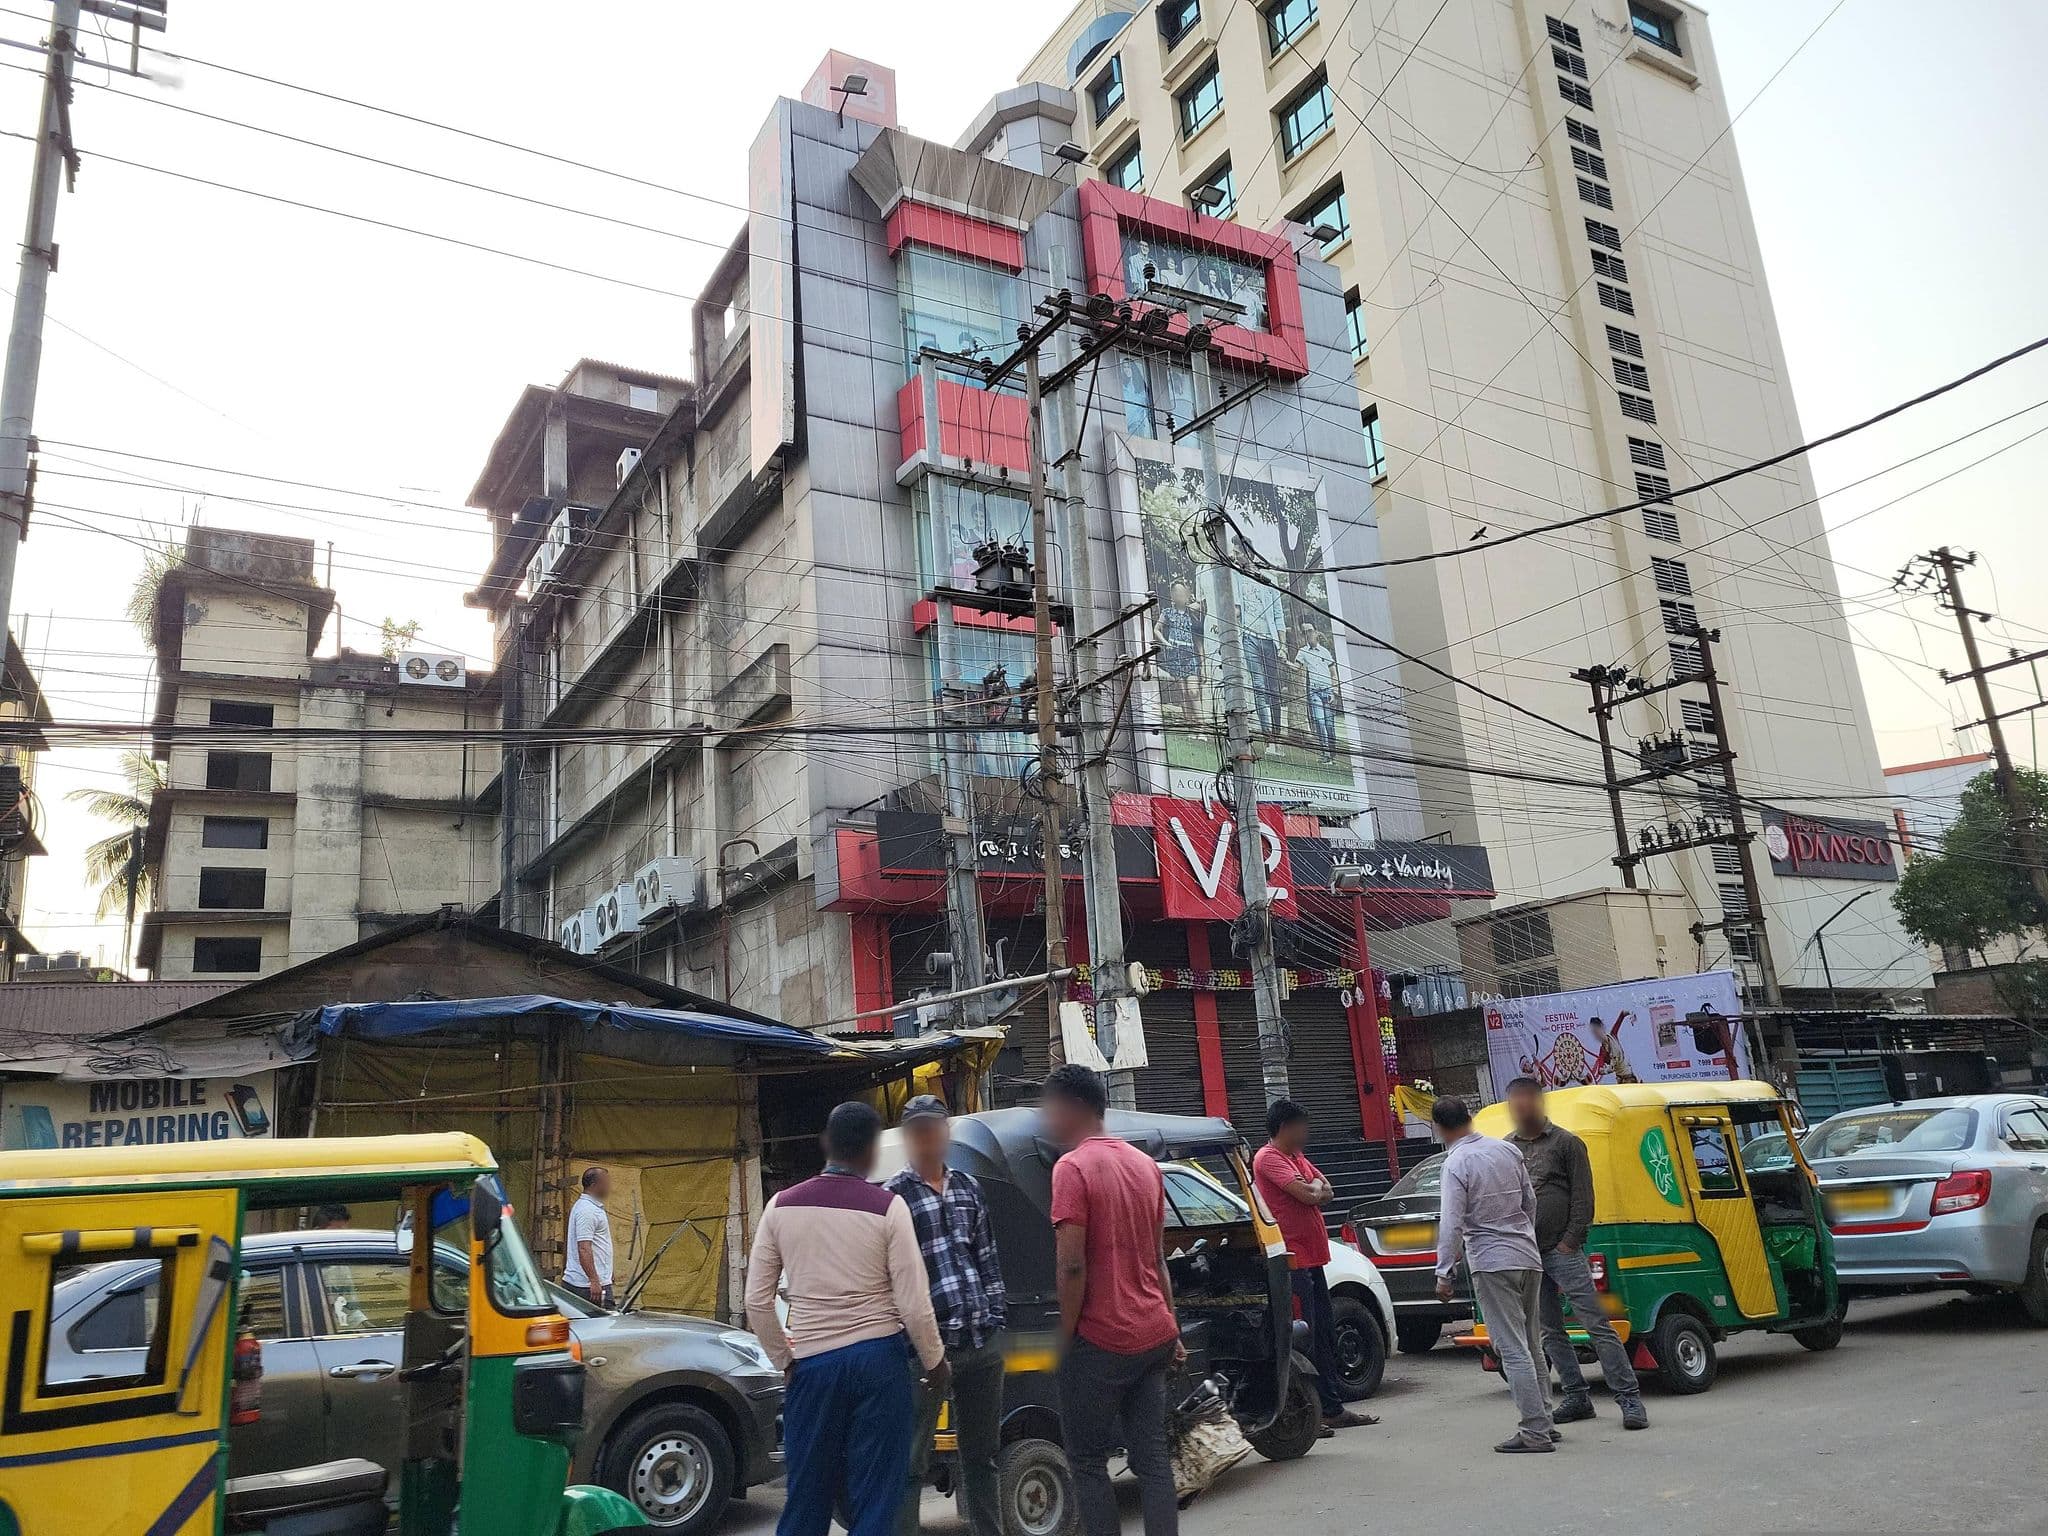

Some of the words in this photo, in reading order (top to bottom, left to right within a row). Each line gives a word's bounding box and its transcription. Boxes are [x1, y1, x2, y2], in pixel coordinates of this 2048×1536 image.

[1177, 778, 1185, 789] A
[1279, 786, 1321, 799] FASHION
[1322, 791, 1352, 802] STORE
[1332, 852, 1378, 877] Vlue
[1381, 858, 1395, 881] &
[1394, 853, 1454, 889] Variety
[1489, 1015, 1501, 1028] V2
[1545, 1012, 1579, 1023] FESTIVAL
[1550, 1023, 1576, 1033] OFFER
[90, 1079, 207, 1113] MOBILE
[62, 1110, 230, 1149] REPAIRING
